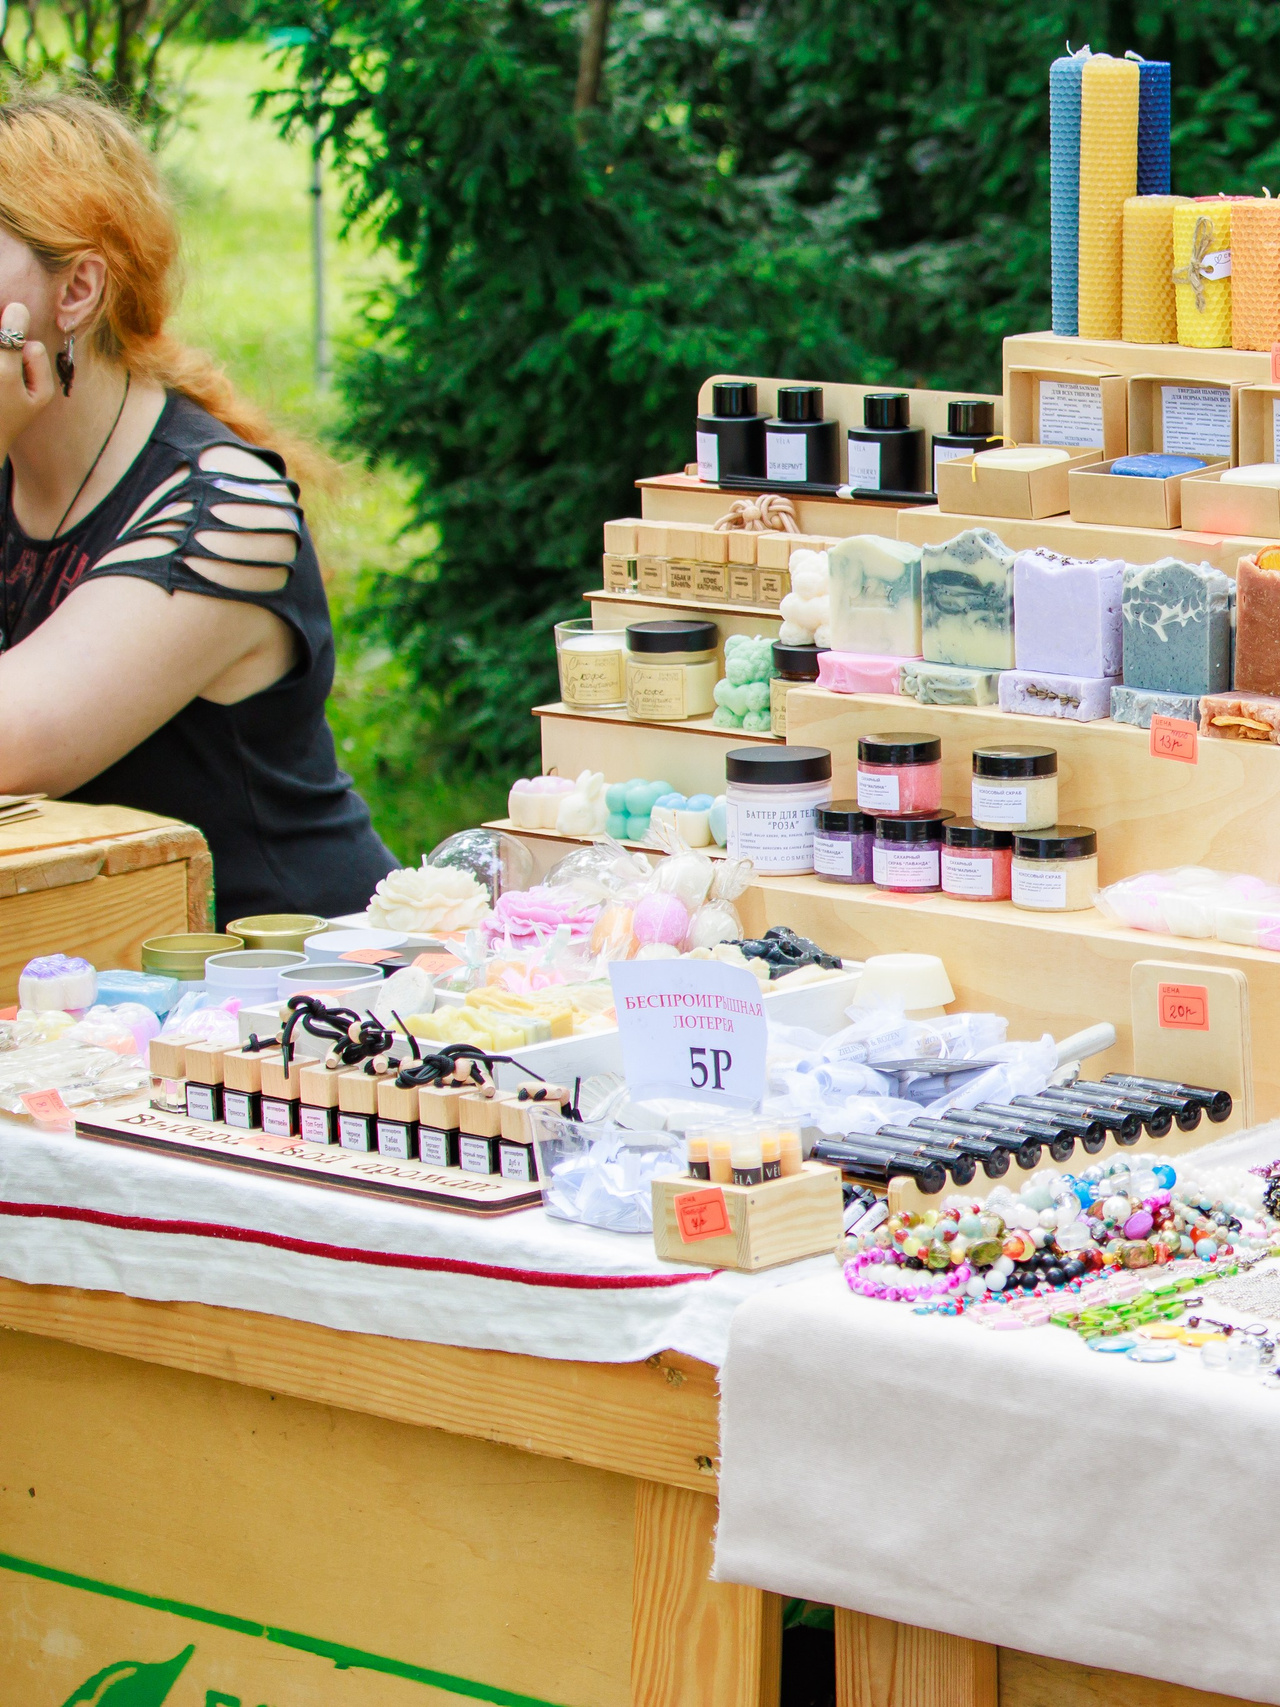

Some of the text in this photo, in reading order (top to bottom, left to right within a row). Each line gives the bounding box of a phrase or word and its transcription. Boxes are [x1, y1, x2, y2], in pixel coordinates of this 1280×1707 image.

[746, 808, 817, 820] БАТТЕР ДЛЯ ТЕЛ
[624, 993, 763, 1017] БЕСПРОИГРЫШНАЯ
[672, 1015, 735, 1033] ЛОТЕРЕЯ
[689, 1046, 732, 1091] 5Р
[190, 1102, 209, 1110] Пряности
[228, 1108, 246, 1117] Пряности
[385, 1135, 398, 1143] Табак
[385, 1144, 401, 1153] Ваниль
[766, 1164, 781, 1178] VÈL
[734, 1172, 753, 1185] ÈLA
